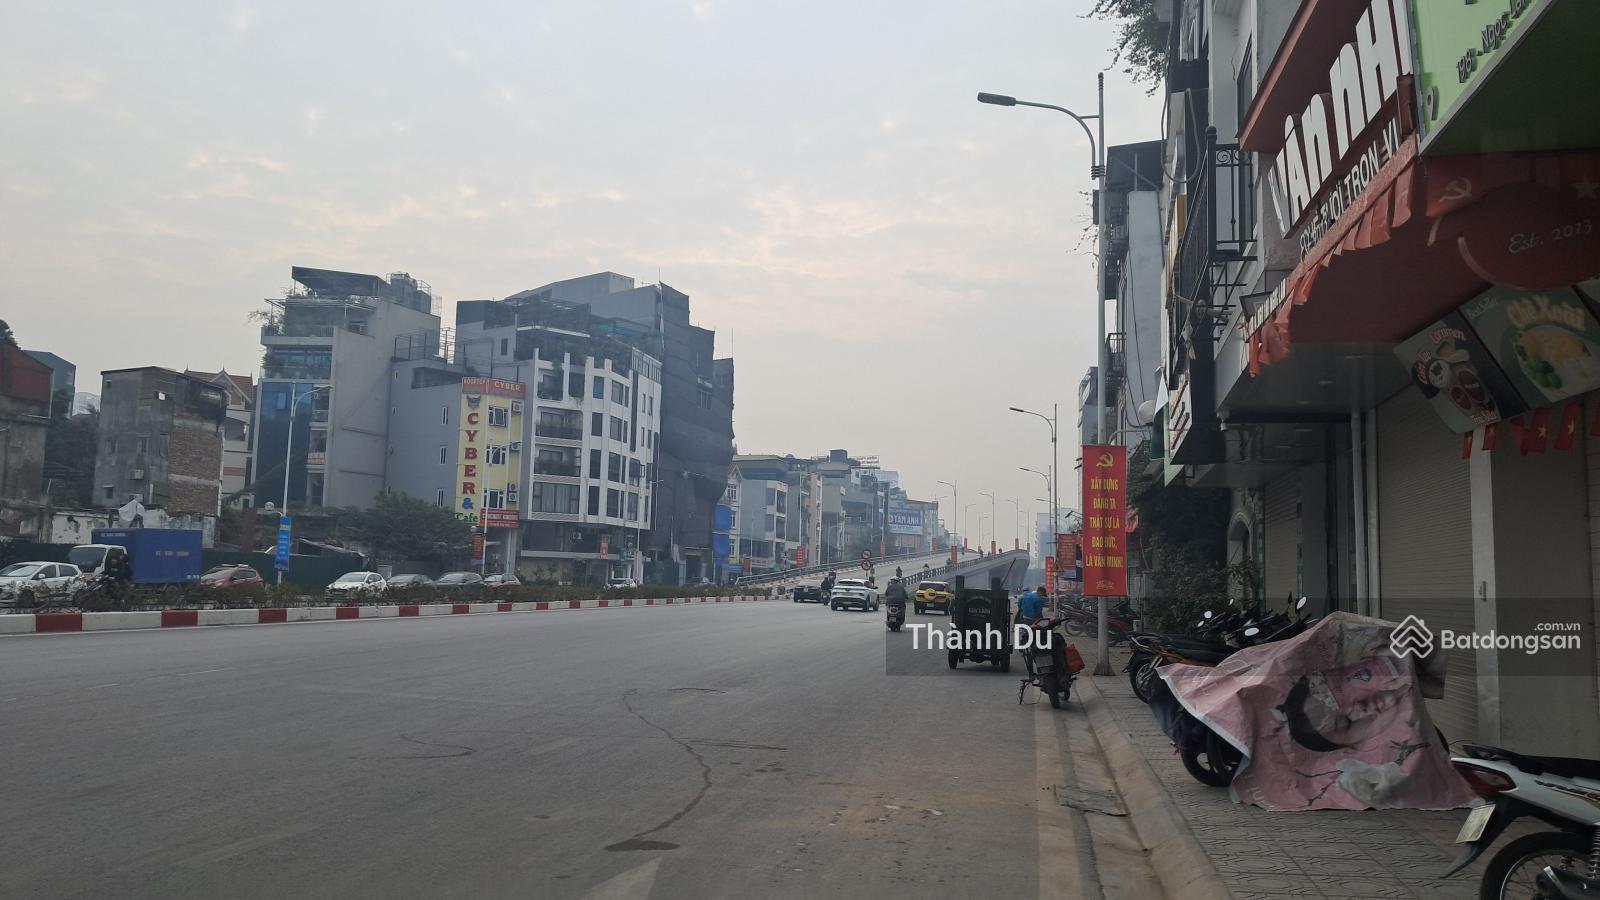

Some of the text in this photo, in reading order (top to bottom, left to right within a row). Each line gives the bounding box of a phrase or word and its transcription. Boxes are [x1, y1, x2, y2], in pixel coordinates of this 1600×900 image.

[1508, 219, 1593, 254] Est. 2013
[494, 381, 521, 392] CYBER
[462, 412, 479, 494] CYBER
[462, 497, 475, 510] &
